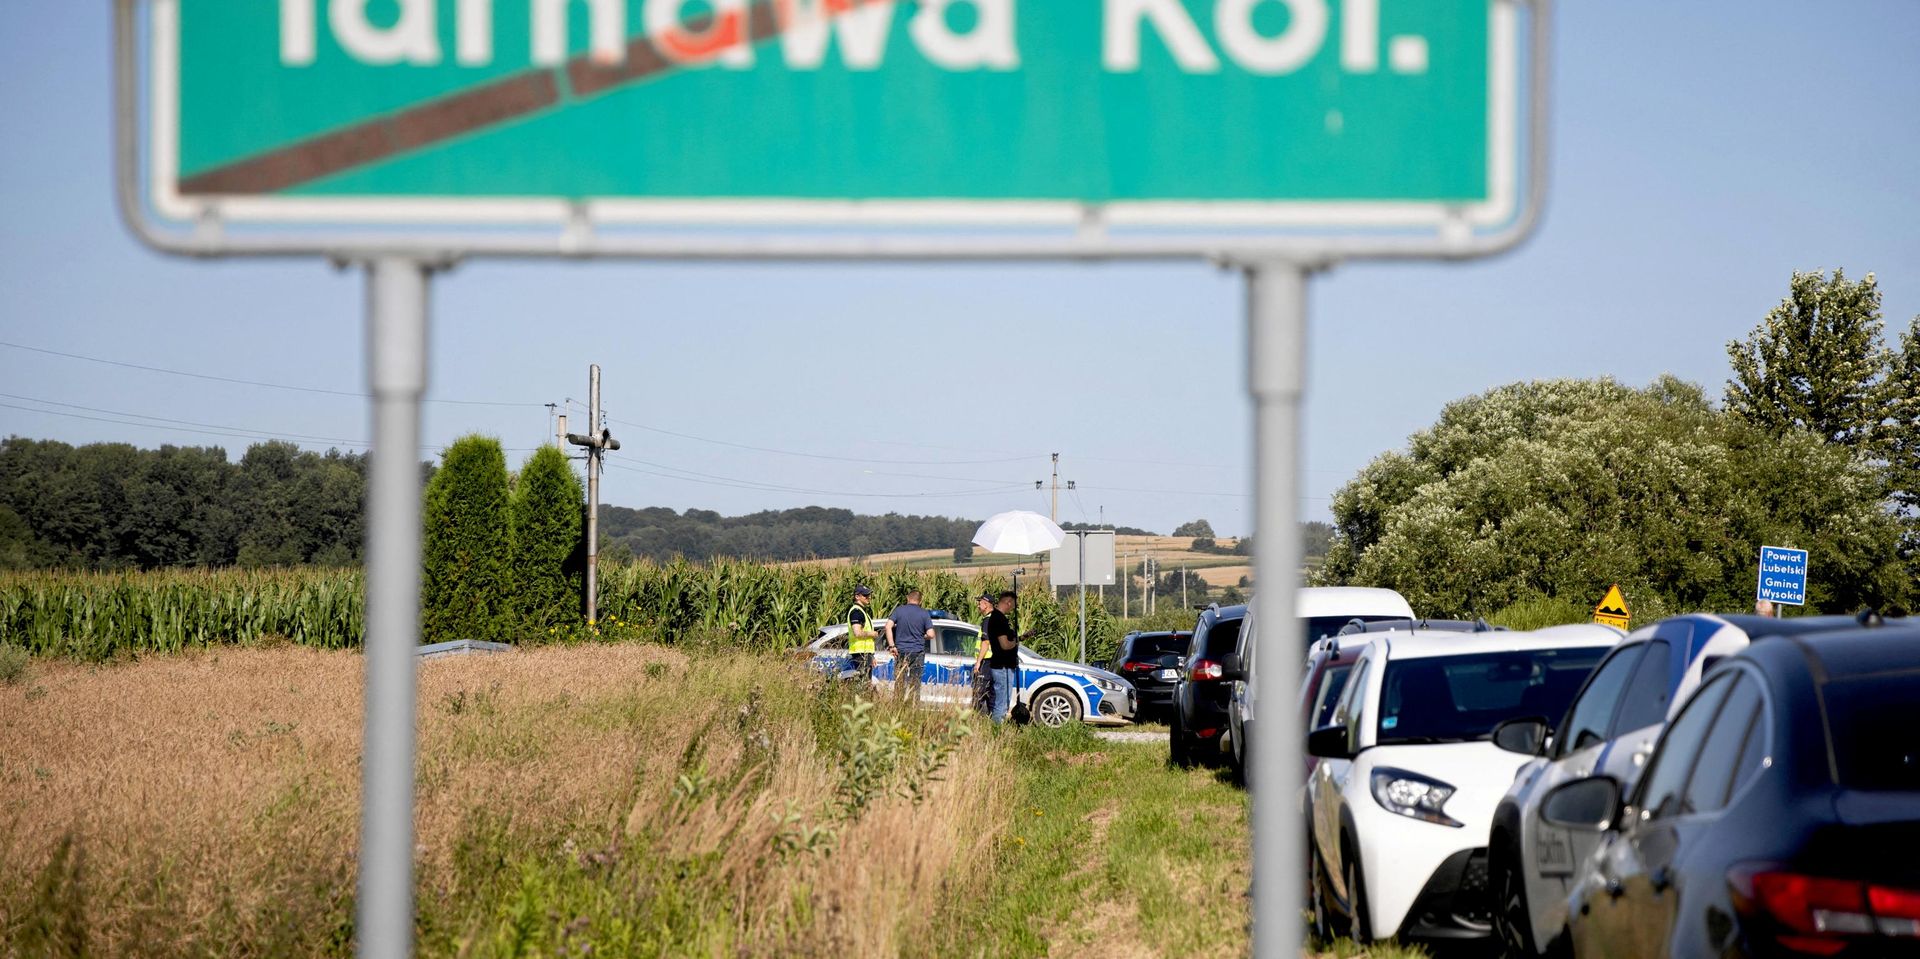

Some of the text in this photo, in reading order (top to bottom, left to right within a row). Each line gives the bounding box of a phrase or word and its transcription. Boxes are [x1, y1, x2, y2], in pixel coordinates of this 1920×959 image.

[1767, 551, 1802, 563] Powiat
[1762, 563, 1804, 575] Lubelski
[1765, 577, 1799, 589] Gmina
[1761, 588, 1803, 601] Wysokie
